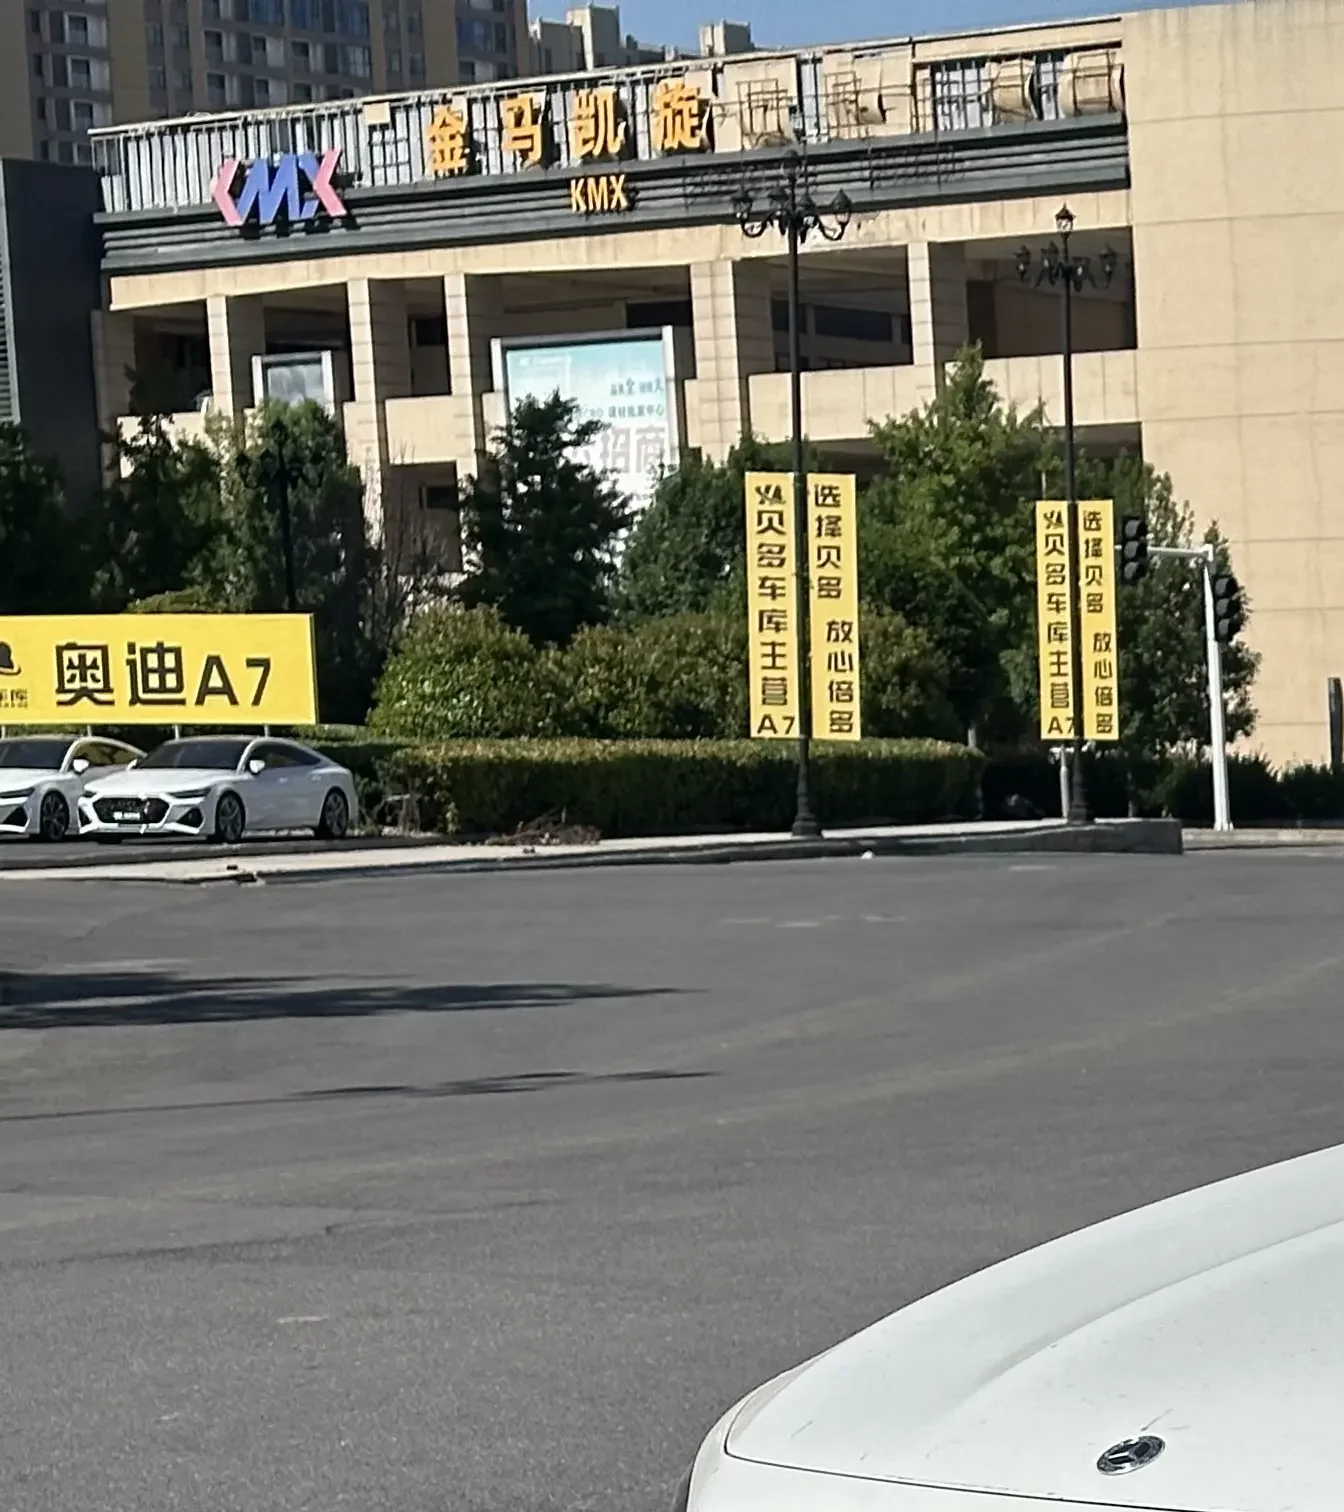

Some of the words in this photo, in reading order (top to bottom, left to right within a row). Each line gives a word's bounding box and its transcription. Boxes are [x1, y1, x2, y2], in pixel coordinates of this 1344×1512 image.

[426, 76, 701, 172] 金马凯旋
[570, 174, 628, 213] KMX
[814, 484, 843, 600] 选择贝多
[1083, 511, 1104, 613] 选择贝多
[55, 641, 272, 706] 奥迪A7
[826, 620, 854, 734] 放心倍多
[1093, 632, 1114, 735] 放心倍多
